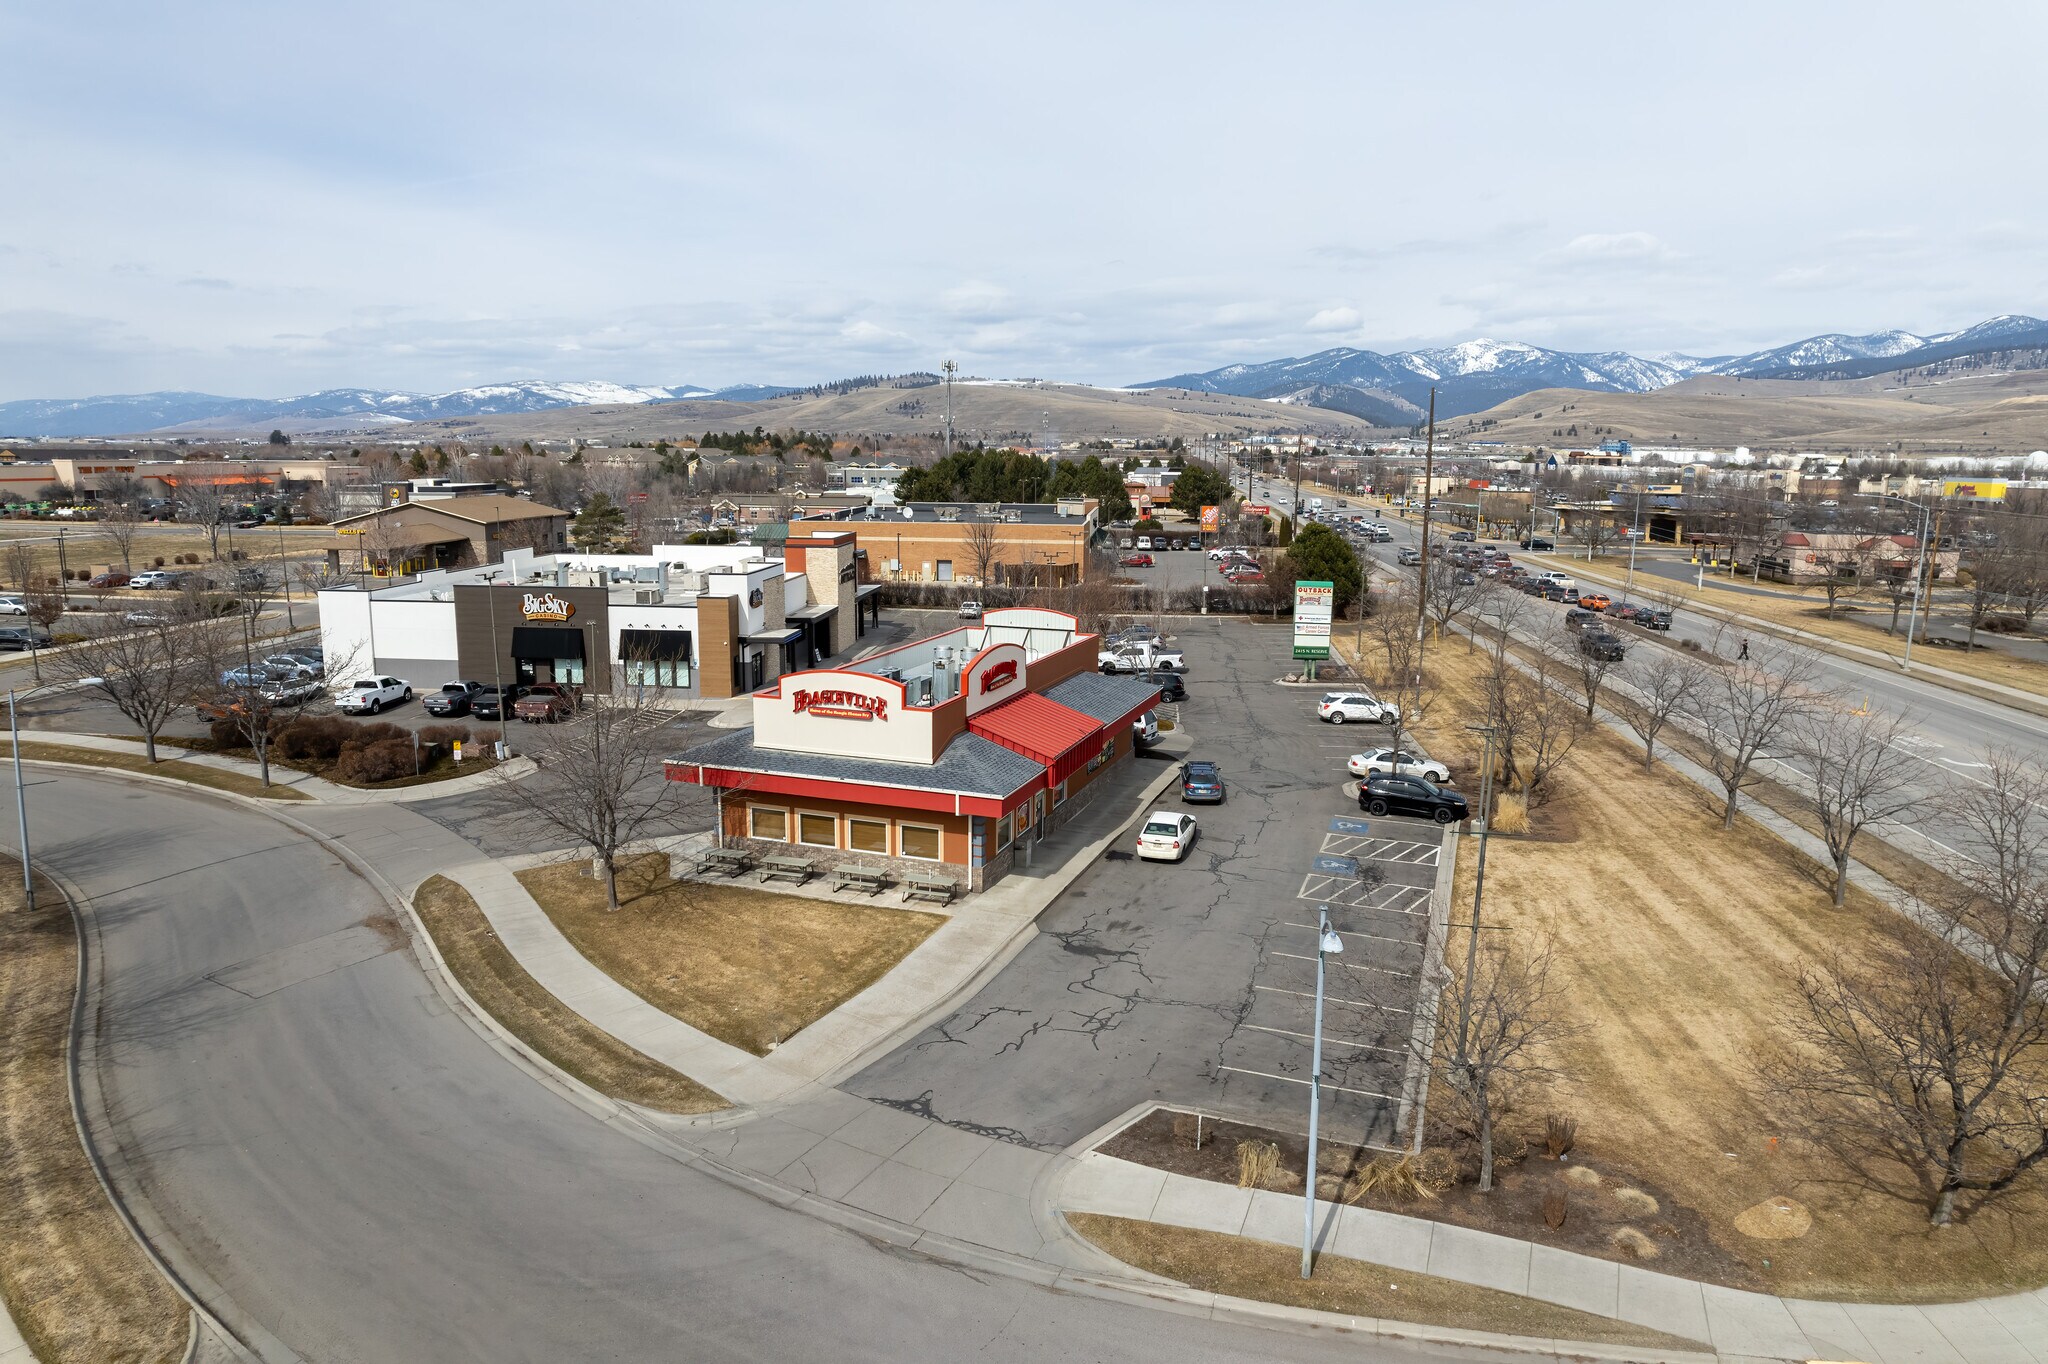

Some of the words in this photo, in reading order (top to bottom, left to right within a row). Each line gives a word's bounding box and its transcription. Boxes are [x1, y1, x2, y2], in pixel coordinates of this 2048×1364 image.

[523, 593, 545, 615] BIG
[544, 593, 569, 615] SKY
[792, 689, 888, 722] HOAGIEVILLE
